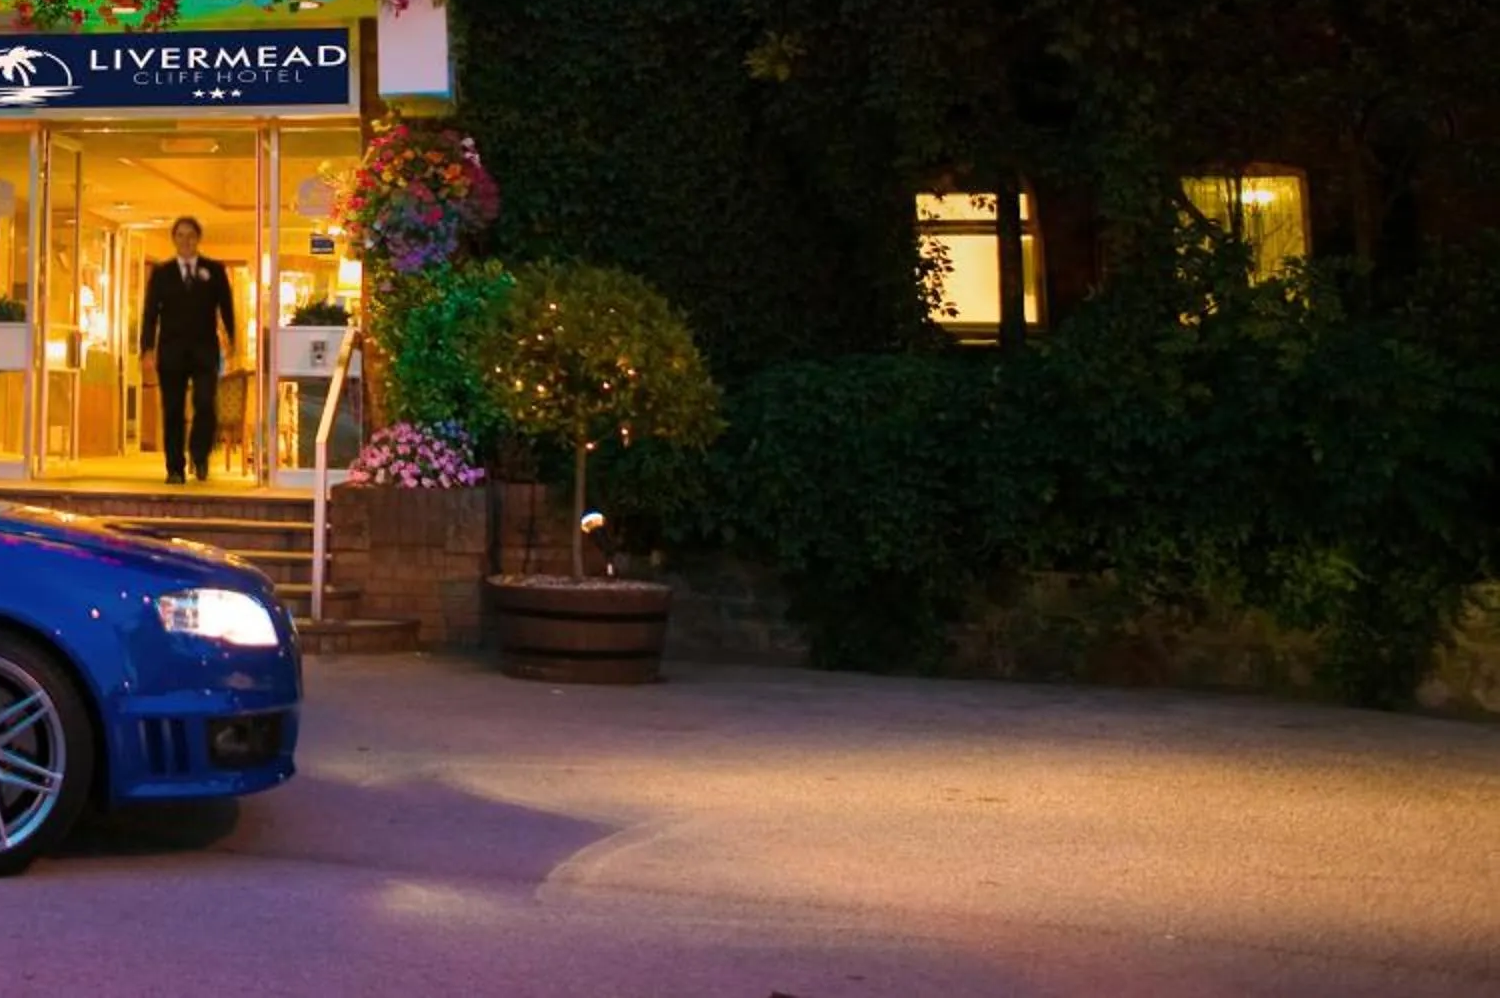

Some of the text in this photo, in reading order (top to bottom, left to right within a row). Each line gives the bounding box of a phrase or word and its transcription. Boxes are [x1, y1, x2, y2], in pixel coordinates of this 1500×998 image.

[90, 45, 347, 70] LIVERMEAD
[133, 69, 304, 85] CLIFF HOTEL
